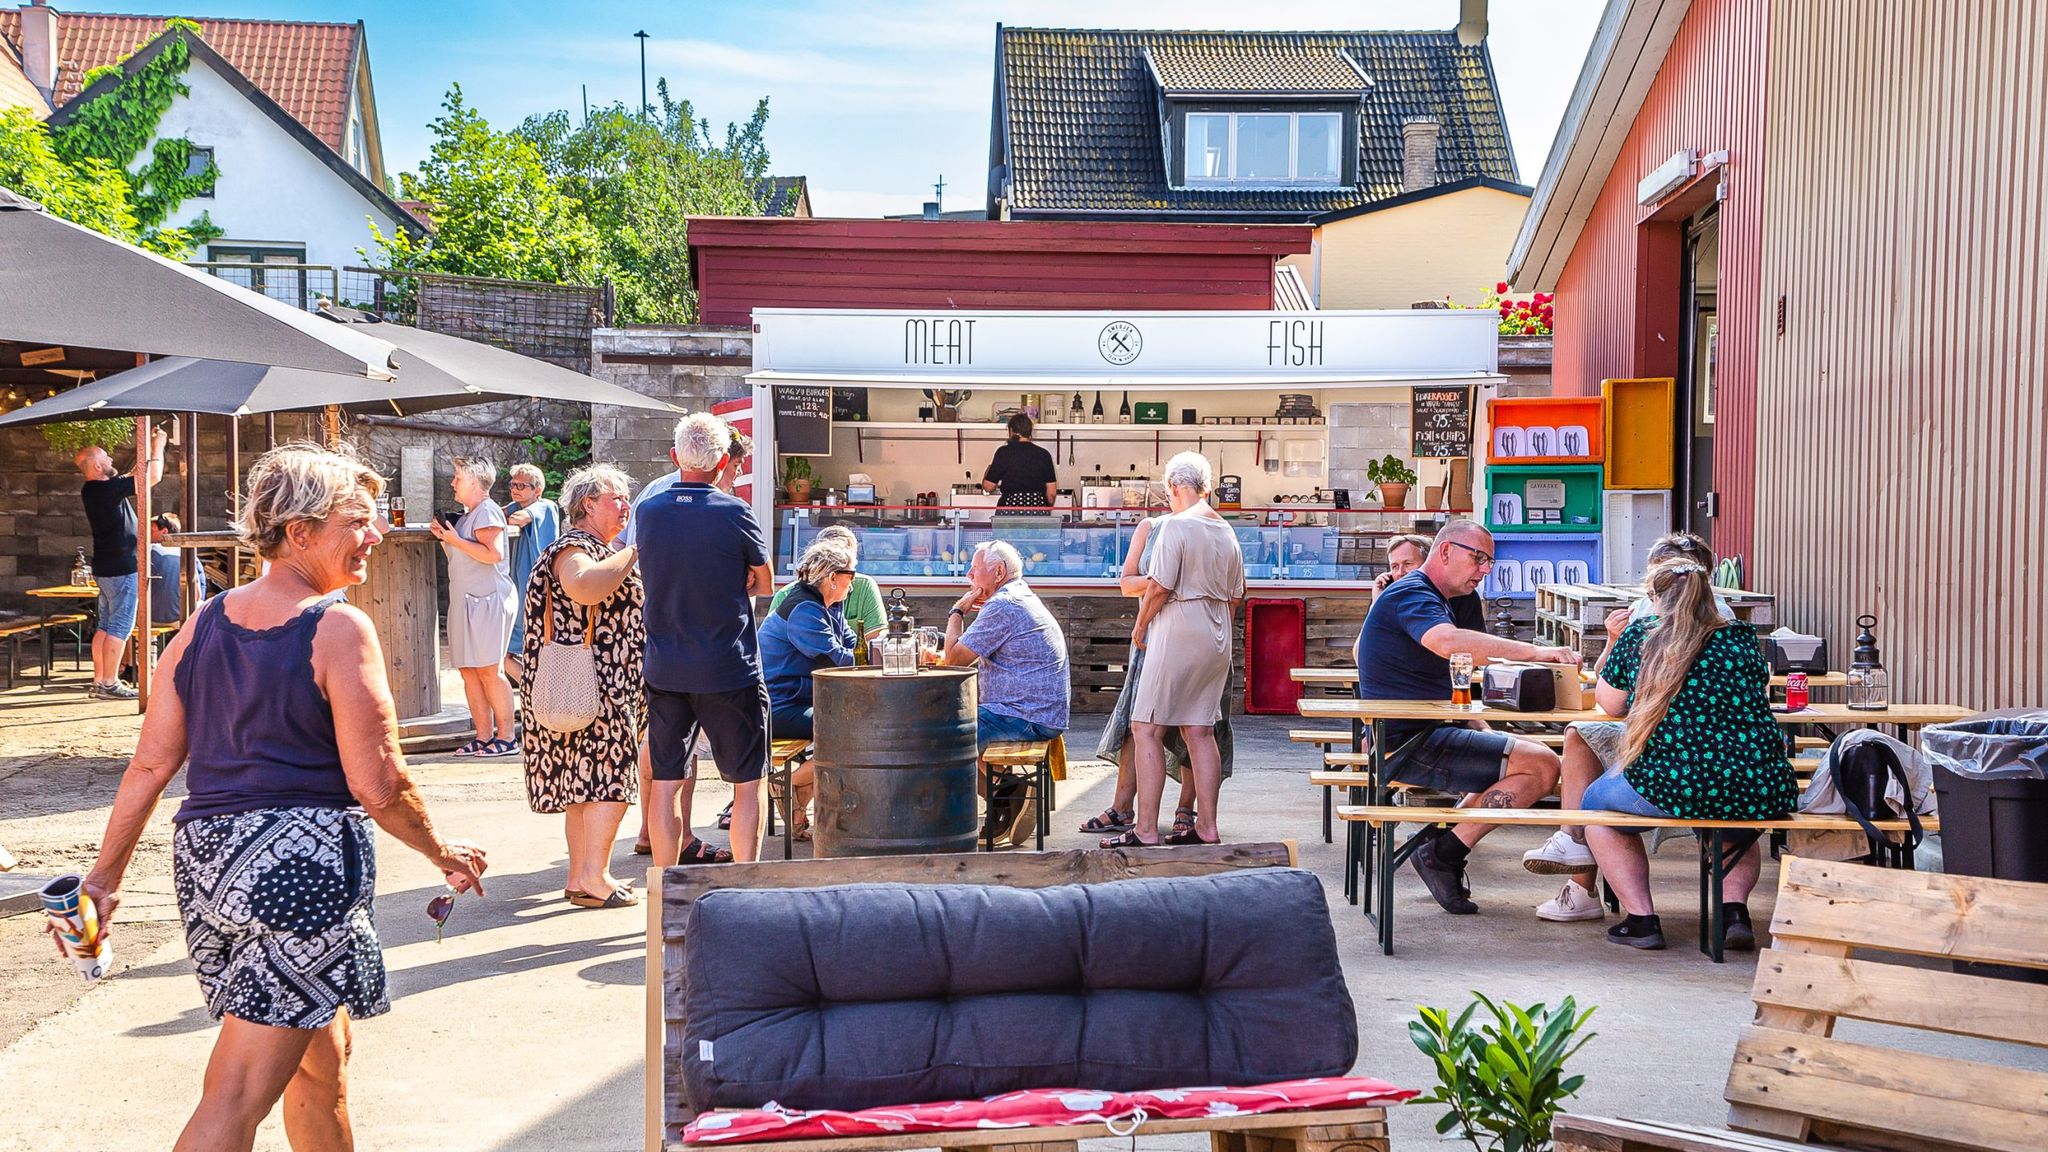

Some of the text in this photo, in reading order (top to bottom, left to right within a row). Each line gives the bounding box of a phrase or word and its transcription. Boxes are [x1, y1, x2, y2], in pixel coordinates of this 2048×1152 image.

[904, 319, 977, 365] MEAT
[1266, 319, 1323, 367] FISH
[805, 388, 830, 397] BURGER
[1415, 430, 1435, 442] FISH
